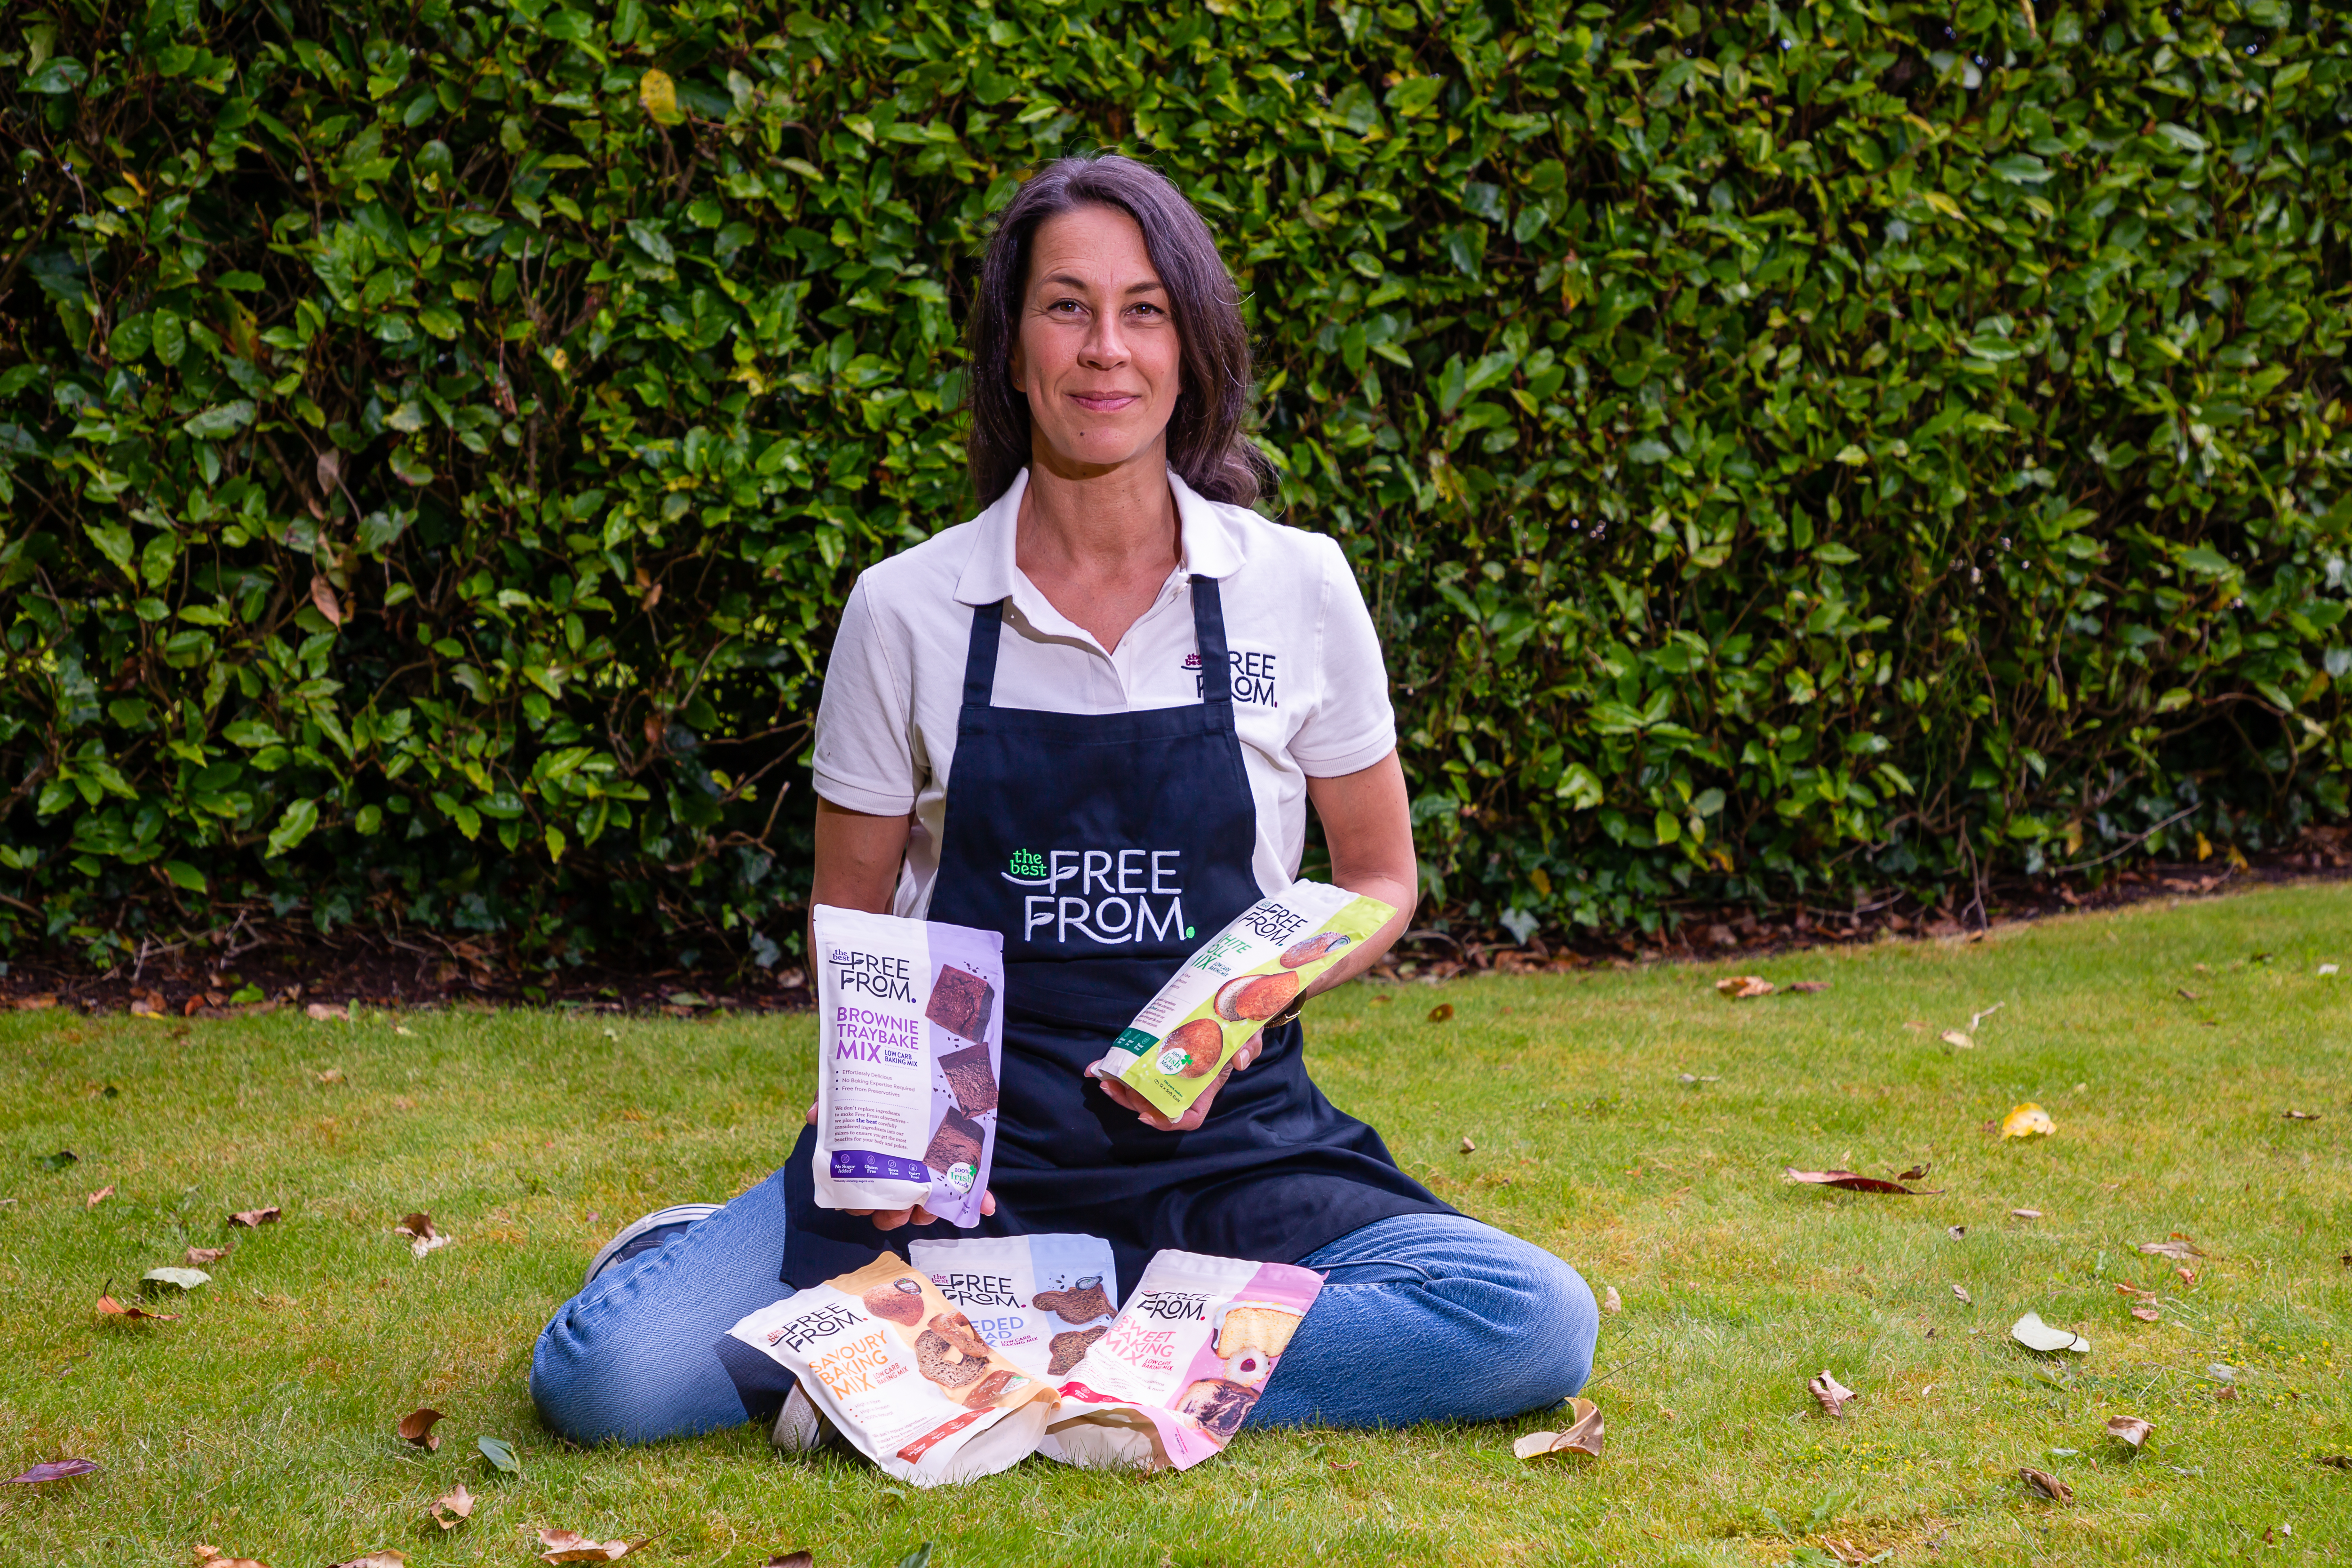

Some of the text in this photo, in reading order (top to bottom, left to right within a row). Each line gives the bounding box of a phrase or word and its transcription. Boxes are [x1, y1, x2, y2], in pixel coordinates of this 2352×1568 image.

[1228, 651, 1276, 680] REE
[1196, 675, 1278, 708] FOM.
[1013, 849, 1042, 865] the
[1010, 860, 1047, 876] best
[1049, 850, 1182, 895] FREE
[1025, 895, 1195, 944] FROM.
[1261, 903, 1309, 933] FREE
[1238, 912, 1291, 947] FROM.
[1207, 944, 1229, 958] OLL
[1217, 933, 1252, 954] HITE
[833, 953, 850, 962] best
[851, 951, 910, 980] FREE
[841, 970, 916, 1003] FROM.
[837, 1007, 918, 1035] BROWNIE
[837, 1024, 919, 1050] TRAYBAKE
[836, 1039, 882, 1064] MIX
[885, 1056, 906, 1065] BAKING
[1163, 1053, 1180, 1069] Irish
[1160, 1059, 1173, 1072] Made
[868, 1088, 900, 1097] Preservatives
[875, 1108, 900, 1116] ingredients
[880, 1115, 906, 1124] alternatives
[951, 1172, 971, 1183] Irish
[954, 1180, 969, 1189] Made
[950, 1274, 1014, 1294] FREE
[942, 1289, 1026, 1308] FROM.
[782, 1303, 847, 1335] FREE
[1136, 1300, 1205, 1321] FROM.
[767, 1329, 781, 1337] the
[785, 1311, 868, 1353] FROM.
[970, 1317, 1024, 1331] EDED
[1122, 1315, 1176, 1342] SWEET
[768, 1330, 786, 1343] best
[1110, 1323, 1175, 1357] BAKING
[809, 1329, 887, 1373] SAVOURY
[1098, 1331, 1145, 1367] MIX
[818, 1350, 888, 1385] BAKING
[873, 1362, 900, 1379] LOW CARB
[876, 1366, 909, 1385] BAKING MIX
[831, 1372, 877, 1401] MIX
[1142, 1378, 1165, 1387] occasions
[904, 1417, 927, 1429] ingredients
